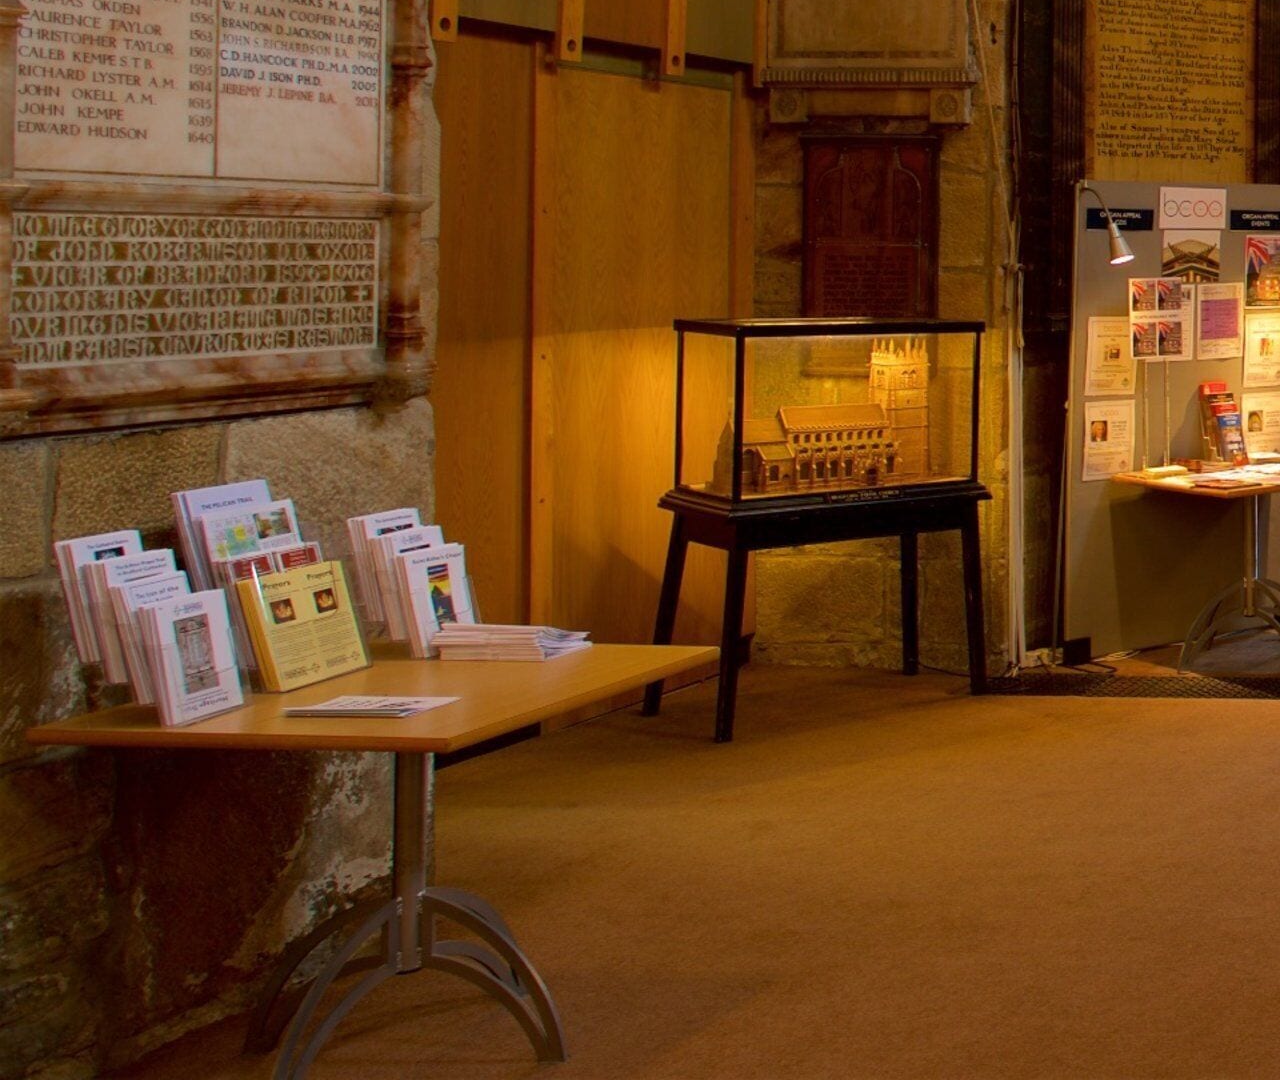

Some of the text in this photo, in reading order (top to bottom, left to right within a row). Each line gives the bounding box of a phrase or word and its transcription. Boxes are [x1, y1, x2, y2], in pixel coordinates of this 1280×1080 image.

[220, 66, 255, 80] DAVID
[268, 71, 293, 84] ISON
[351, 79, 376, 92] 2005
[18, 101, 64, 117] JOHN
[77, 106, 124, 121] KEMPE
[16, 120, 83, 136] EDWARD
[86, 124, 147, 140] HUDSON
